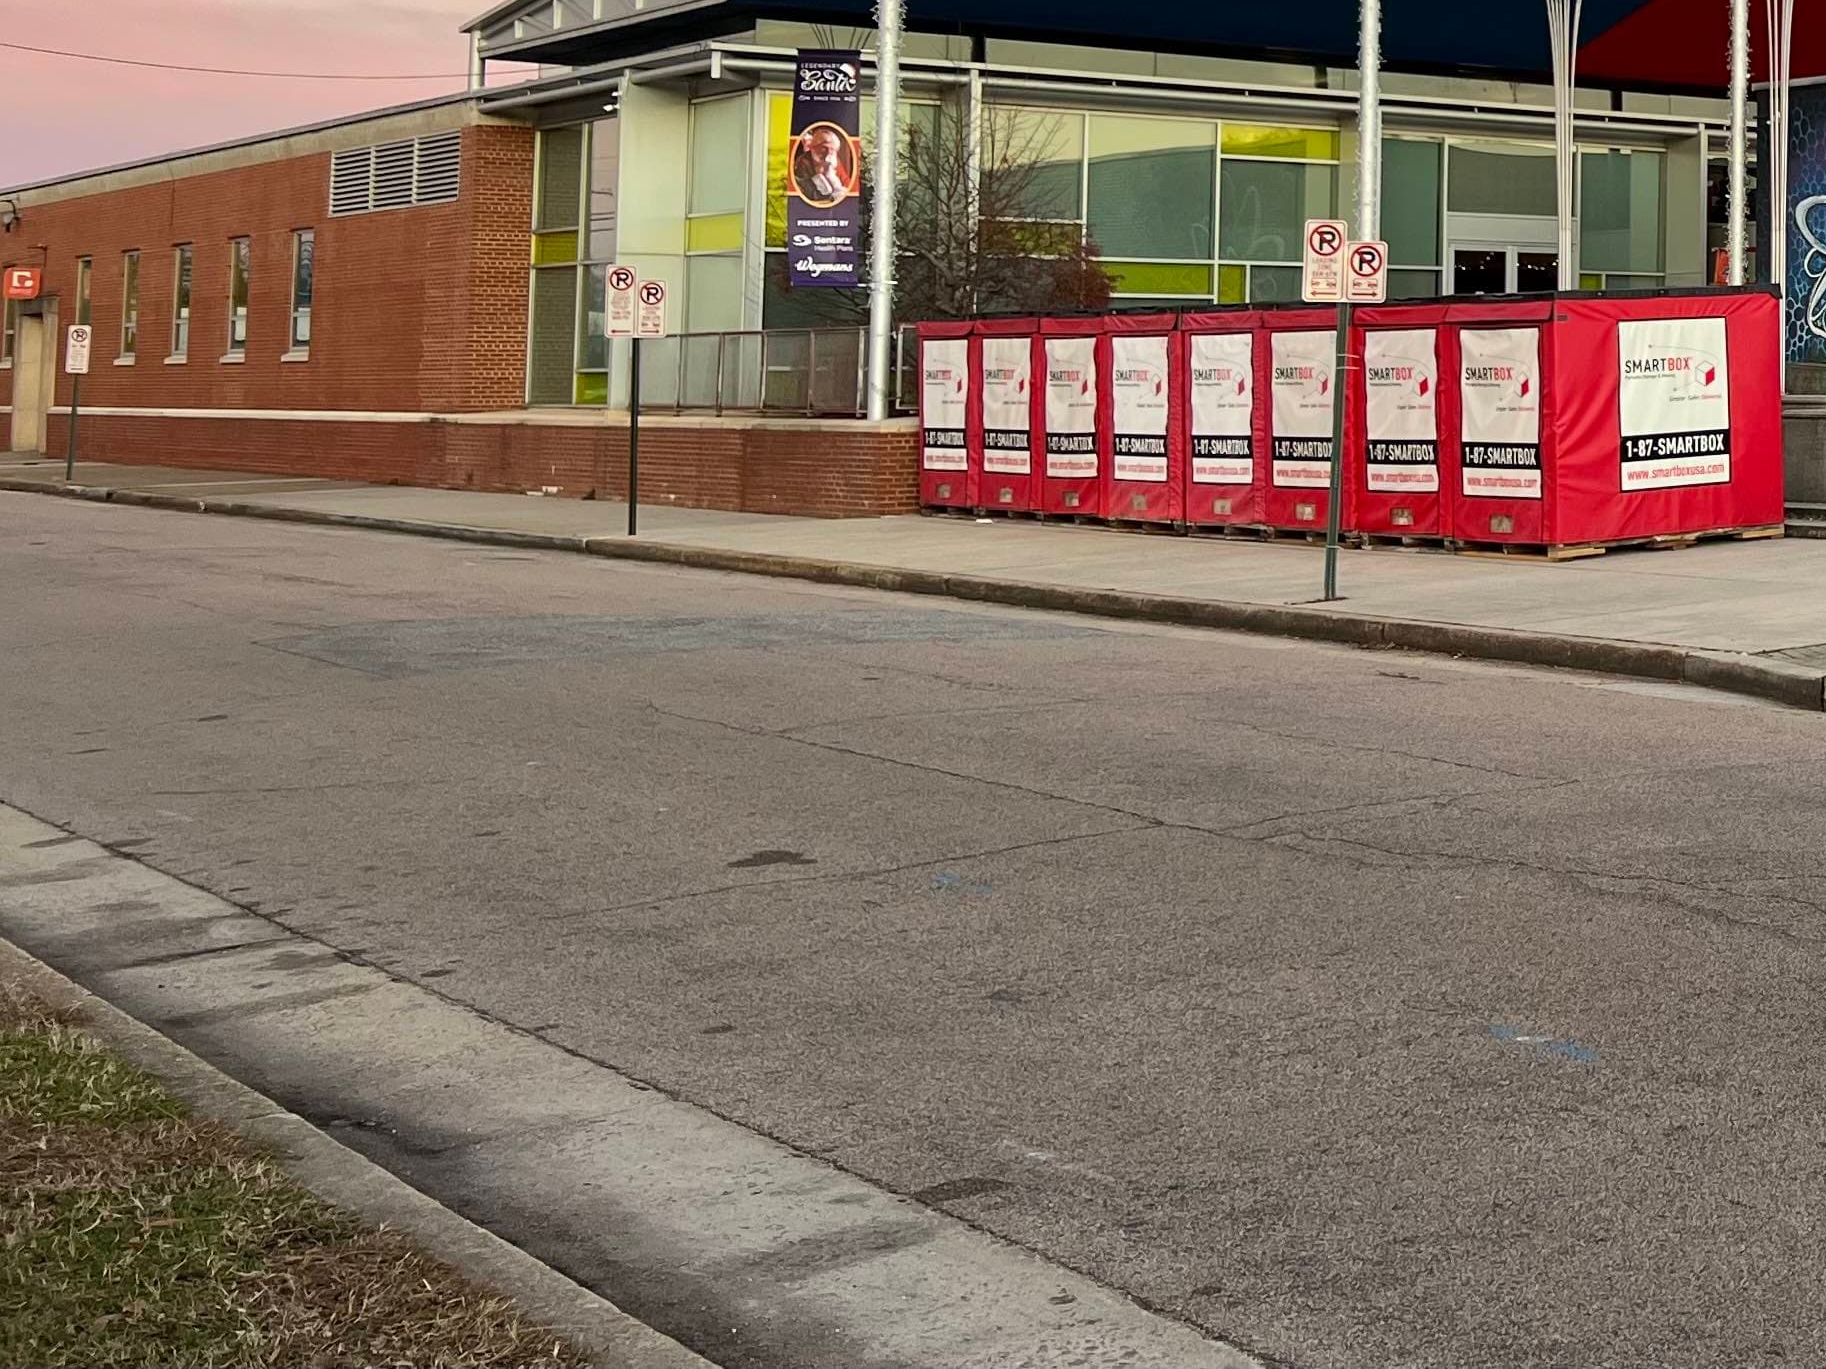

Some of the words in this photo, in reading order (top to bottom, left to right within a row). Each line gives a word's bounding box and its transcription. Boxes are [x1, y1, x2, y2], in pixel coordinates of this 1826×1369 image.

[800, 69, 856, 92] Santa
[795, 256, 854, 277] Wegmans
[1275, 367, 1313, 380] SMARTBOX
[1369, 367, 1413, 380] SMARTBOX
[1465, 367, 1513, 380] SMARTBOX
[1625, 357, 1691, 373] SMARTBOX
[1369, 444, 1435, 461] 1-87-SMARTBOX
[1626, 434, 1725, 458] 1-87-SMARTBOX
[1465, 447, 1537, 465] 1-87-SMARTBOX
[1627, 464, 1725, 481] www.smartboxusa.com
